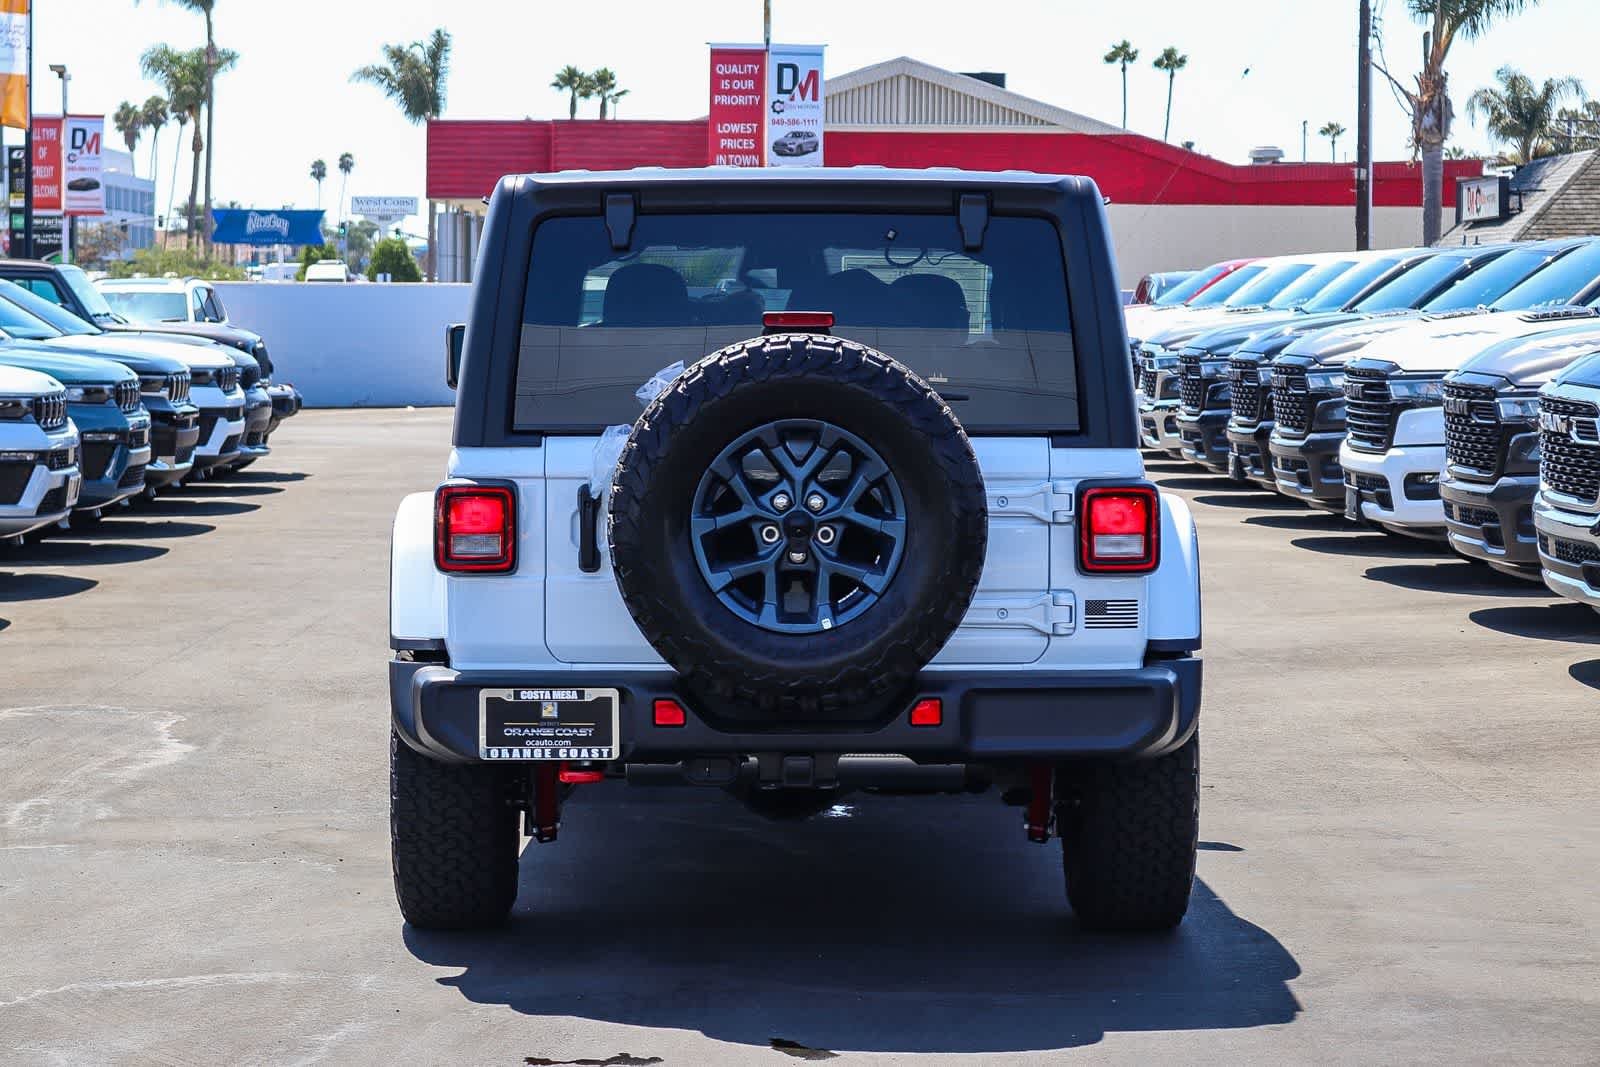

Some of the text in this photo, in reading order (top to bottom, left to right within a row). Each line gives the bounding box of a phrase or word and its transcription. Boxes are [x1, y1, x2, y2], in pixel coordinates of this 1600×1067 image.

[716, 63, 760, 75] QUALITY
[721, 79, 755, 90] IS OUR
[714, 94, 761, 106] PRIORITY
[717, 123, 758, 134] LOWEST
[720, 138, 755, 149] PRICES
[716, 154, 760, 166] IN TOWN
[33, 184, 58, 198] ELCOME
[520, 690, 578, 700] COSTA MESA
[503, 728, 595, 737] ORANGE COAST
[525, 739, 572, 747] ocauto.com
[490, 748, 610, 758] ORANGE COAST
